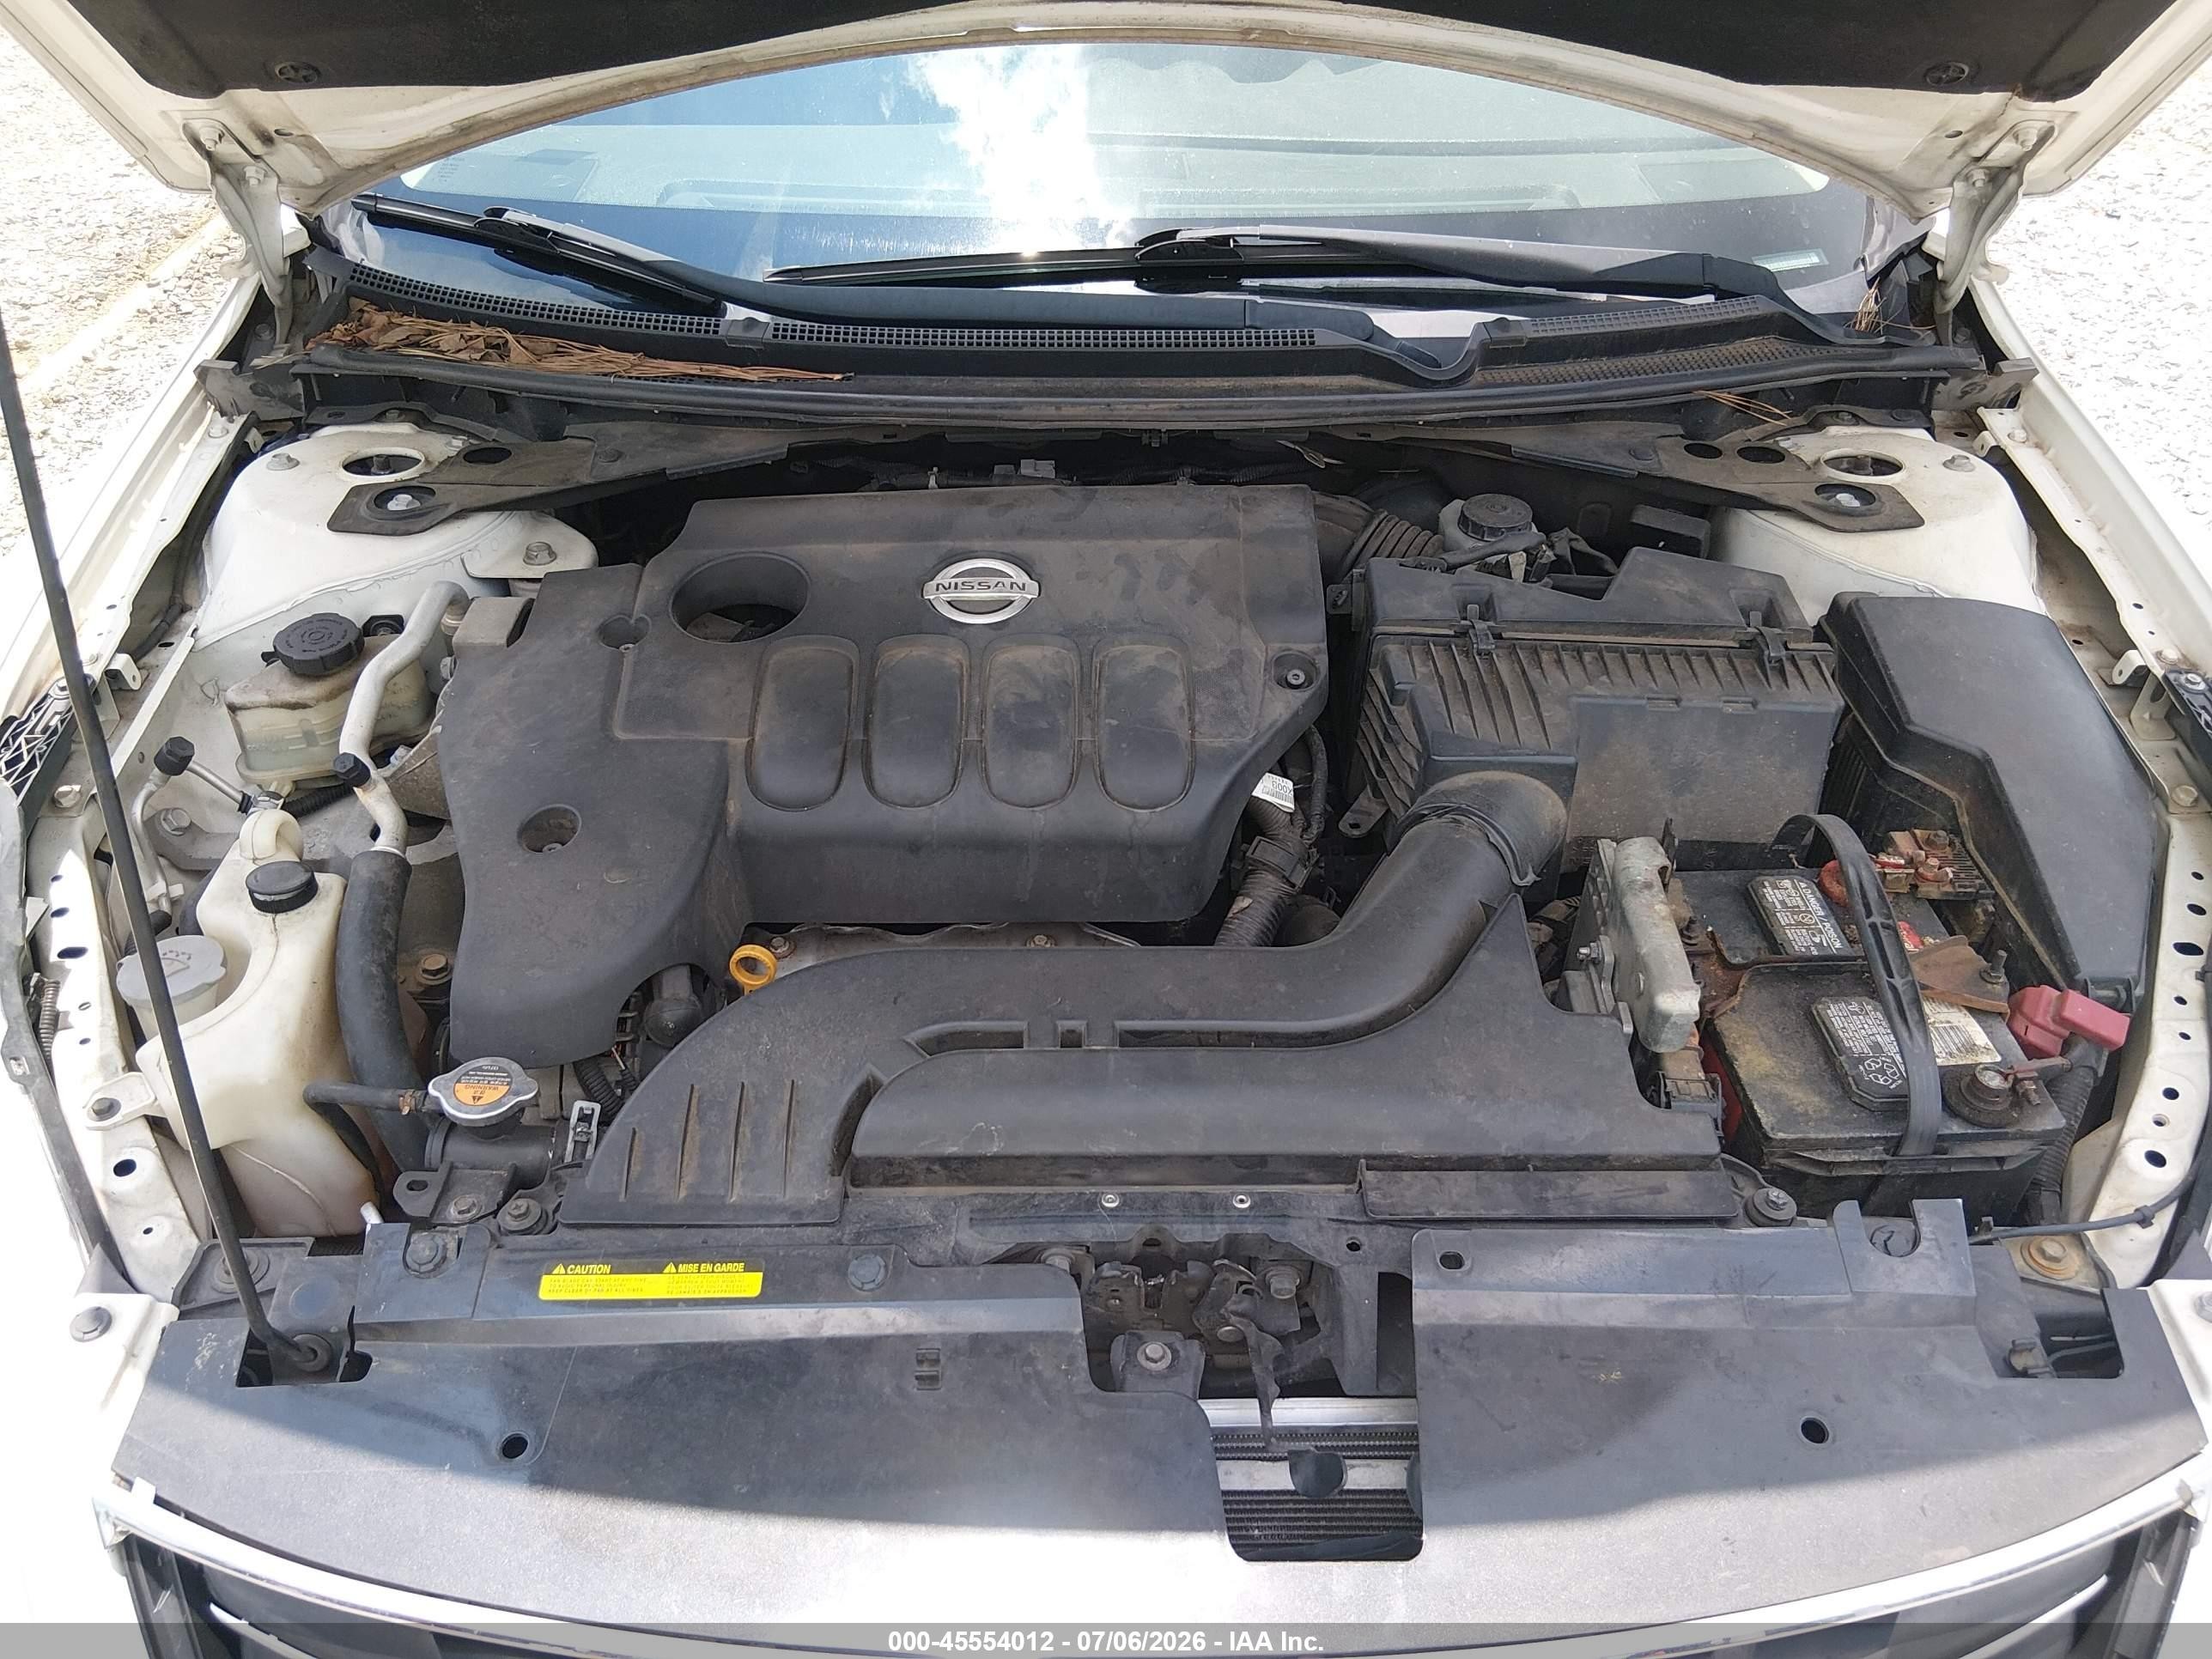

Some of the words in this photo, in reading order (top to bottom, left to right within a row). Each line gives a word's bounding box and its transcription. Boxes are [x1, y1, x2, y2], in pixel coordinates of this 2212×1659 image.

[935, 580, 1026, 592] NISSAN
[1802, 888, 1825, 918] DANGER
[1822, 922, 1844, 949] POISON
[567, 1264, 611, 1274] CAUTION
[678, 1263, 699, 1273] MISE
[700, 1263, 713, 1272] EN
[714, 1262, 744, 1272] GARDE
